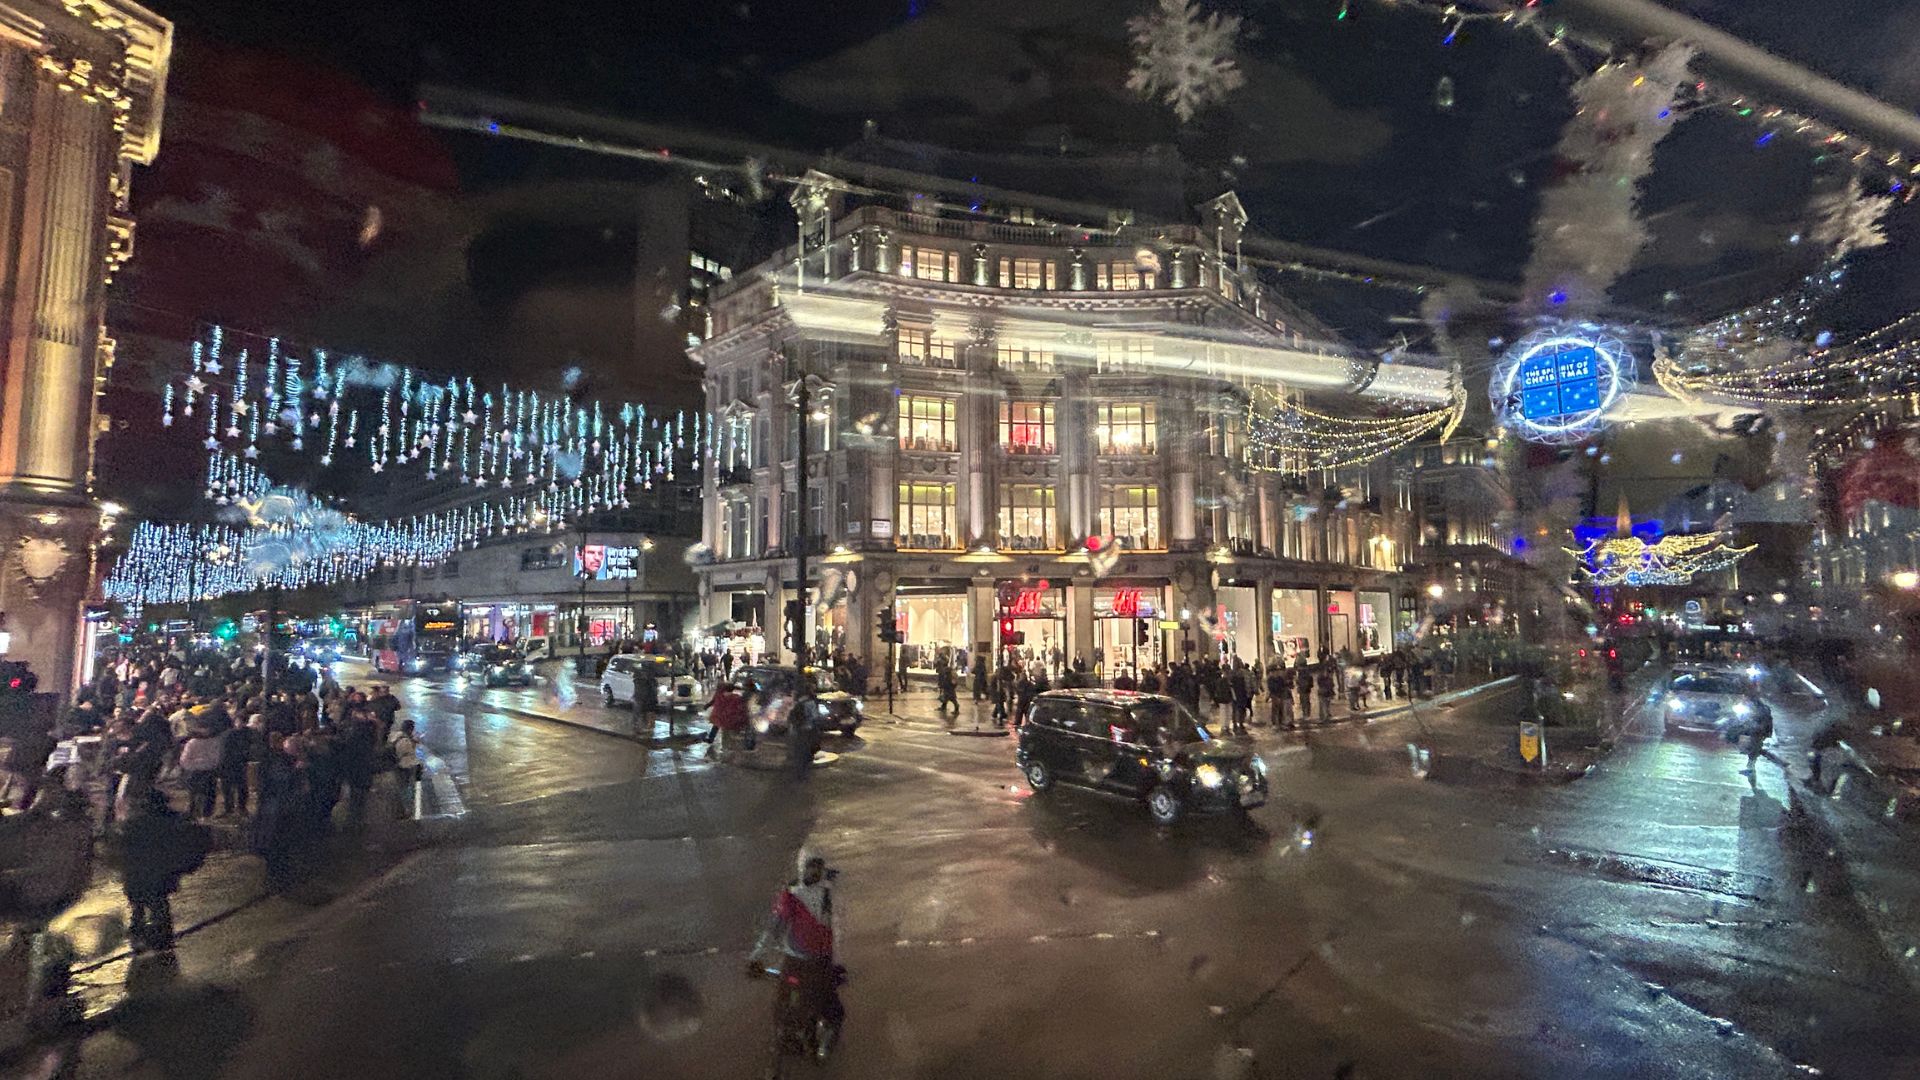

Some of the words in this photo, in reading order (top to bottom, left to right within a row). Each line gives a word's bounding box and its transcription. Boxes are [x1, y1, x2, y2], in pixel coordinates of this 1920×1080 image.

[1525, 370, 1540, 378] THE
[1576, 361, 1588, 369] OF
[1727, 624, 1739, 633] 22
